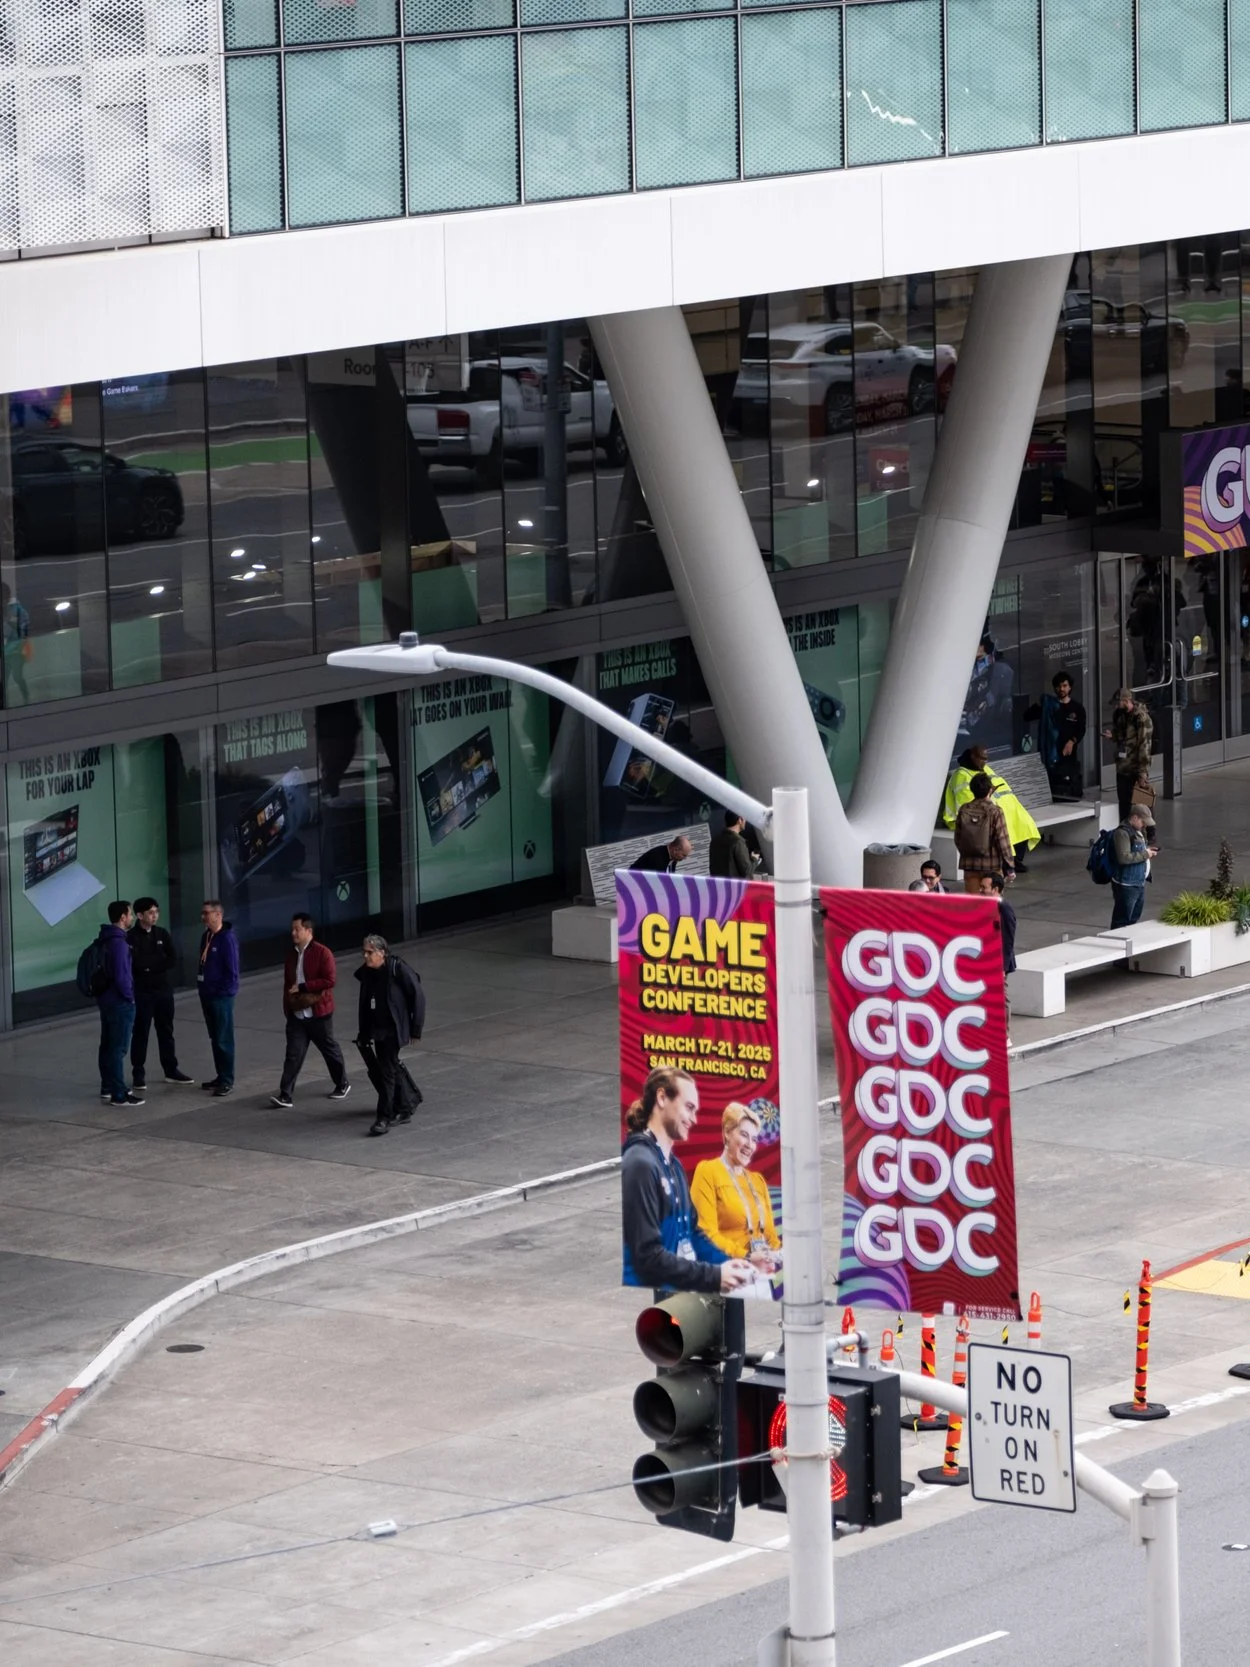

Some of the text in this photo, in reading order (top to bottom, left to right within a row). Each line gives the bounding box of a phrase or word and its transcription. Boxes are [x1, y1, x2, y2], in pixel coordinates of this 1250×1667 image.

[795, 614, 803, 632] IS
[805, 612, 816, 630] AN
[818, 608, 840, 628] XBOX
[793, 633, 808, 652] THE
[810, 628, 836, 649] INSIDE
[622, 663, 650, 685] MAKES
[651, 658, 676, 679] CALLS
[421, 674, 493, 704] THIS IS AN XBOX
[425, 702, 447, 723] GOES
[449, 699, 462, 719] ON
[464, 695, 487, 716] YOUR
[226, 710, 303, 741] THIS IS AN XBOX
[223, 730, 307, 763] THAT TAGS ALONG
[19, 746, 101, 779] THIS IS AN XBOX
[26, 770, 95, 801] FOR YOUR LAP
[640, 912, 767, 969] GAME
[642, 962, 766, 994] DEVELOPERS
[842, 929, 986, 1001] GDC
[642, 988, 767, 1020] CONFERENCE
[643, 1033, 772, 1062] MARCH 17-21, 2025
[849, 997, 990, 1070] GDC
[649, 1055, 767, 1079] SAN FRANCISCO, CA
[855, 1065, 993, 1139] GDC
[857, 1134, 997, 1208] GDC
[853, 1203, 999, 1277] GDC
[978, 1305, 1001, 1313] SERVICE
[996, 1361, 1042, 1394] NO
[990, 1401, 1051, 1431] TURN
[1005, 1436, 1038, 1462] ON
[1000, 1468, 1045, 1495] RED
